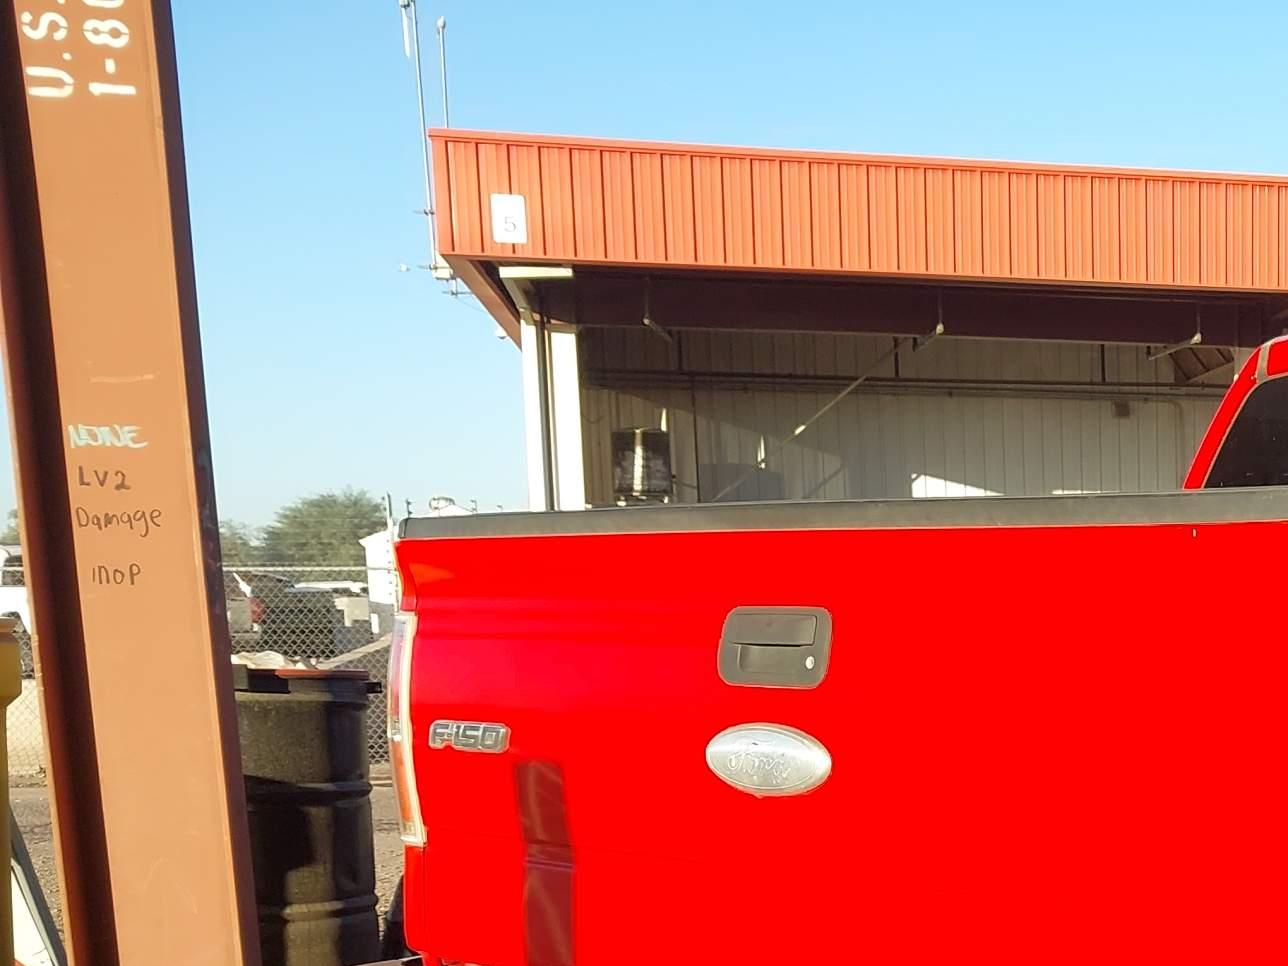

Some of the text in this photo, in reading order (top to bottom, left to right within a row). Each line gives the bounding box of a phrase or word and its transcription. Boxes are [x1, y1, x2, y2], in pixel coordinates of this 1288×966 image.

[82, 0, 137, 96] 1-8
[503, 215, 517, 233] 5
[75, 507, 162, 538] Damage
